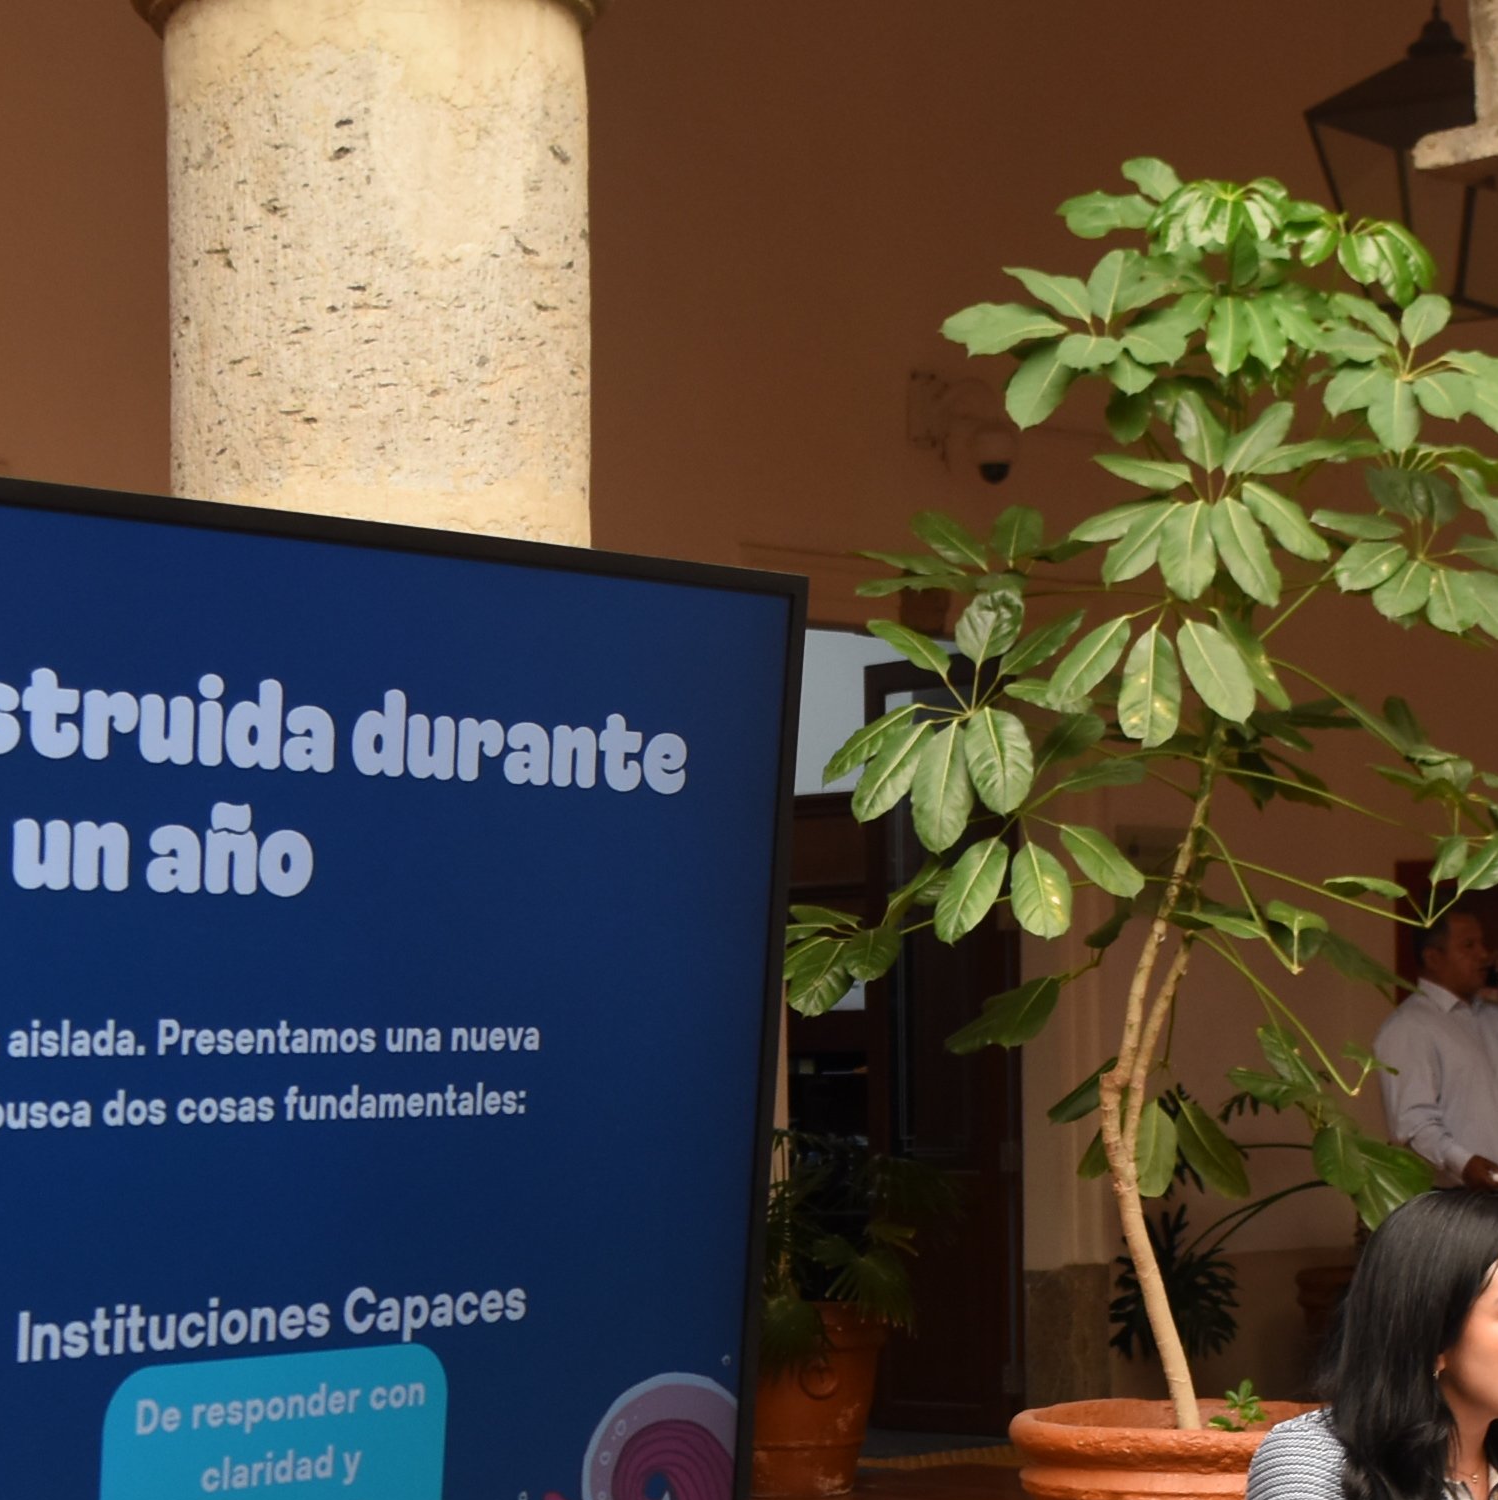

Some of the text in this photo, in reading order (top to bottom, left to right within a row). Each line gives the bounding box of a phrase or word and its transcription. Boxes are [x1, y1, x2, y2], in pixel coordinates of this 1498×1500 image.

[351, 688, 688, 796] durante
[12, 817, 131, 893] un
[145, 800, 315, 898] año
[7, 1018, 146, 1059] aislada.
[156, 1018, 377, 1057] Presentamos
[385, 1026, 442, 1053] una
[450, 1026, 541, 1053] nueva
[102, 1088, 167, 1127] dos
[176, 1095, 275, 1125] cosas
[283, 1081, 527, 1122] fundamentales:
[16, 1285, 527, 1364] Instituciones Capaces
[135, 1382, 426, 1436] De responder con
[200, 1444, 362, 1493] claridad y
